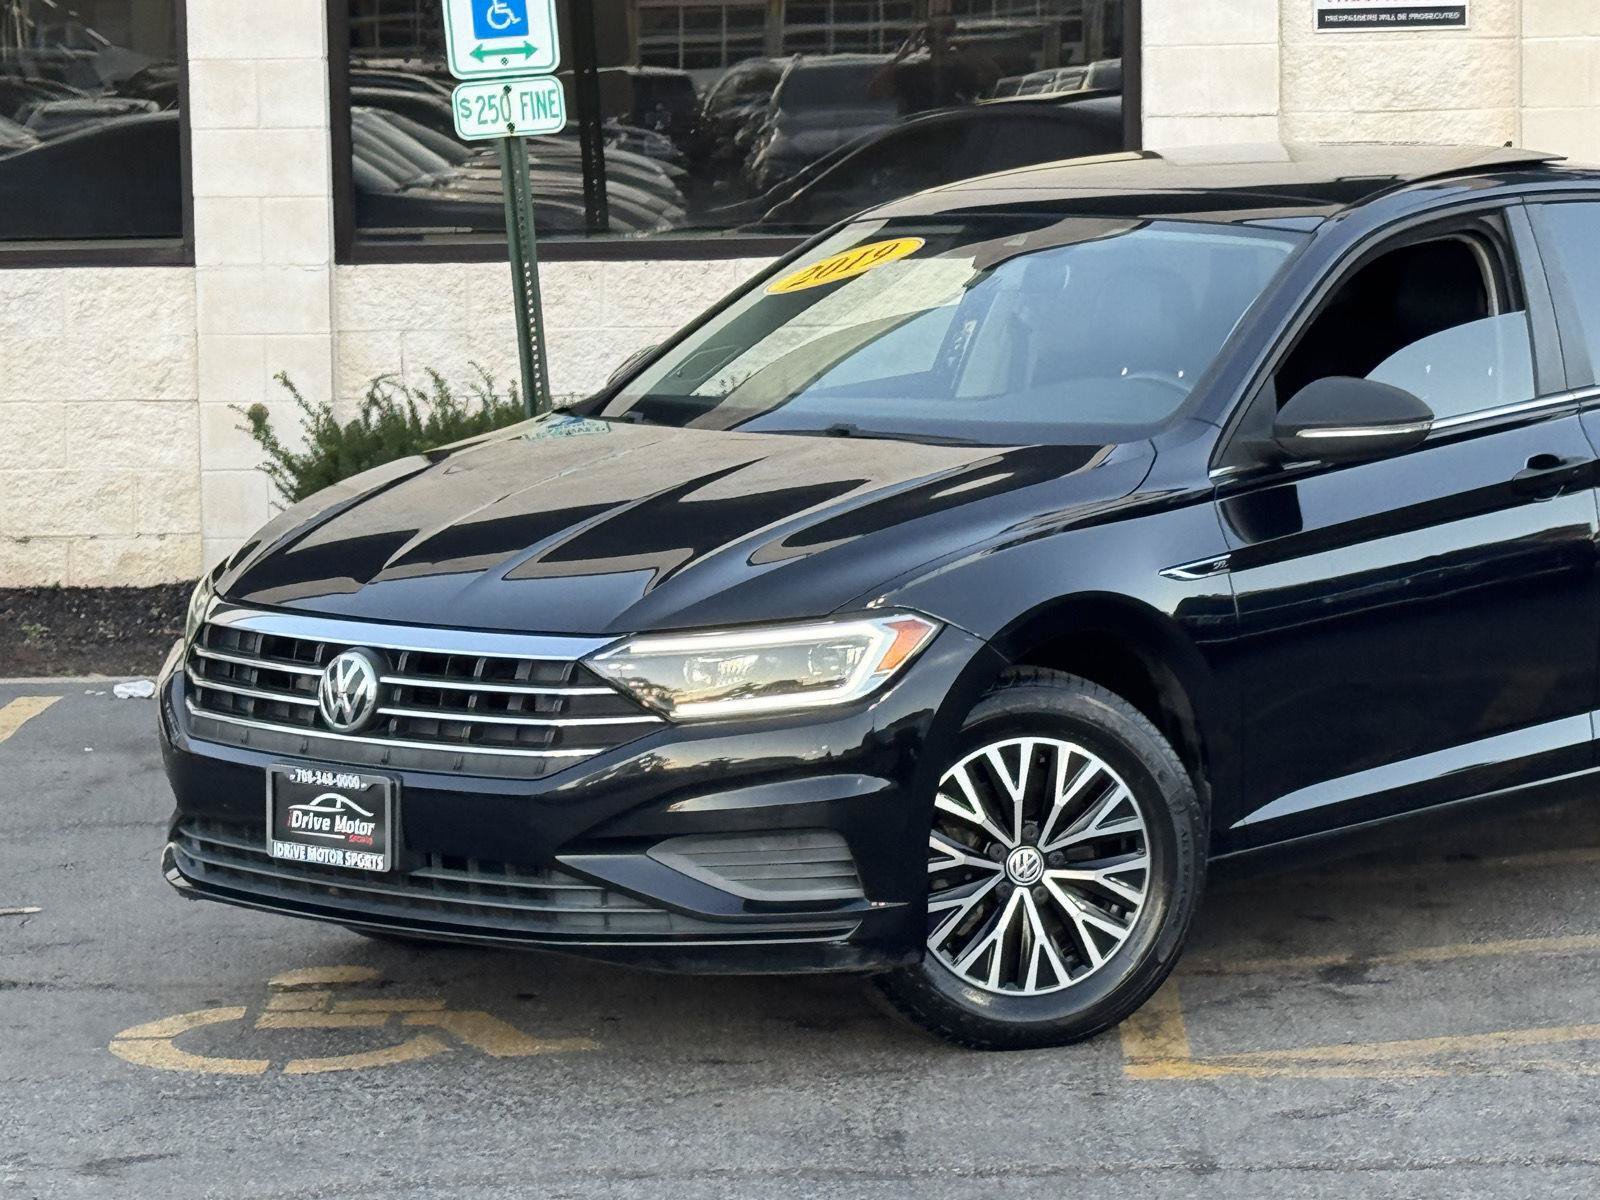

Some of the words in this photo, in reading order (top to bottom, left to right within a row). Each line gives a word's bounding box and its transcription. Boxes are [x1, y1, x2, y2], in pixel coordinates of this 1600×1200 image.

[520, 89, 560, 120] FINE
[785, 242, 901, 290] 2019
[334, 815, 376, 836] Motor
[306, 845, 343, 867] MOTOR
[344, 851, 384, 870] SPORTS
